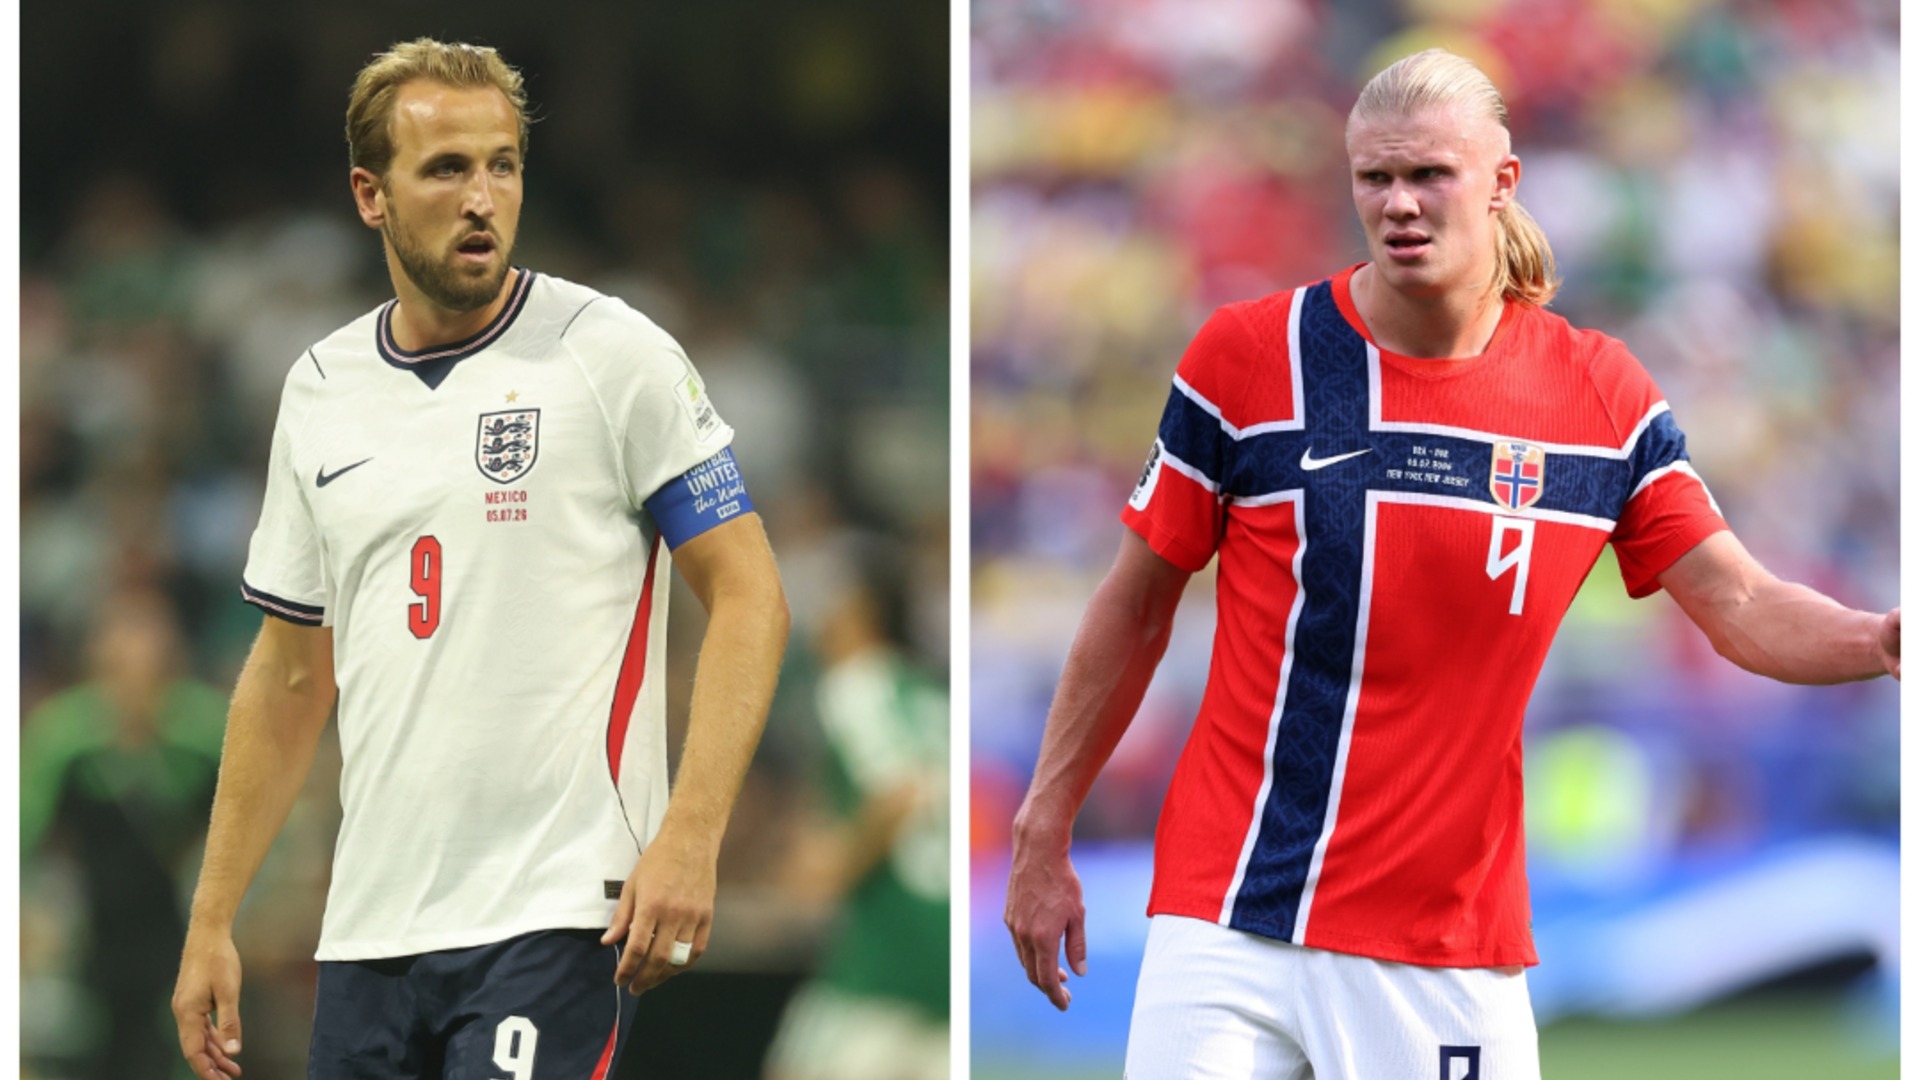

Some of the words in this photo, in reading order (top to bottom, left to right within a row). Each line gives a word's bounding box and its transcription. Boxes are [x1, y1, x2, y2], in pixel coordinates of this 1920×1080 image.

[485, 490, 527, 505] MEXICO
[687, 462, 739, 496] UNITES
[692, 496, 717, 514] the
[408, 535, 443, 639] 9
[1485, 515, 1536, 616] 9
[490, 1015, 538, 1080] 9
